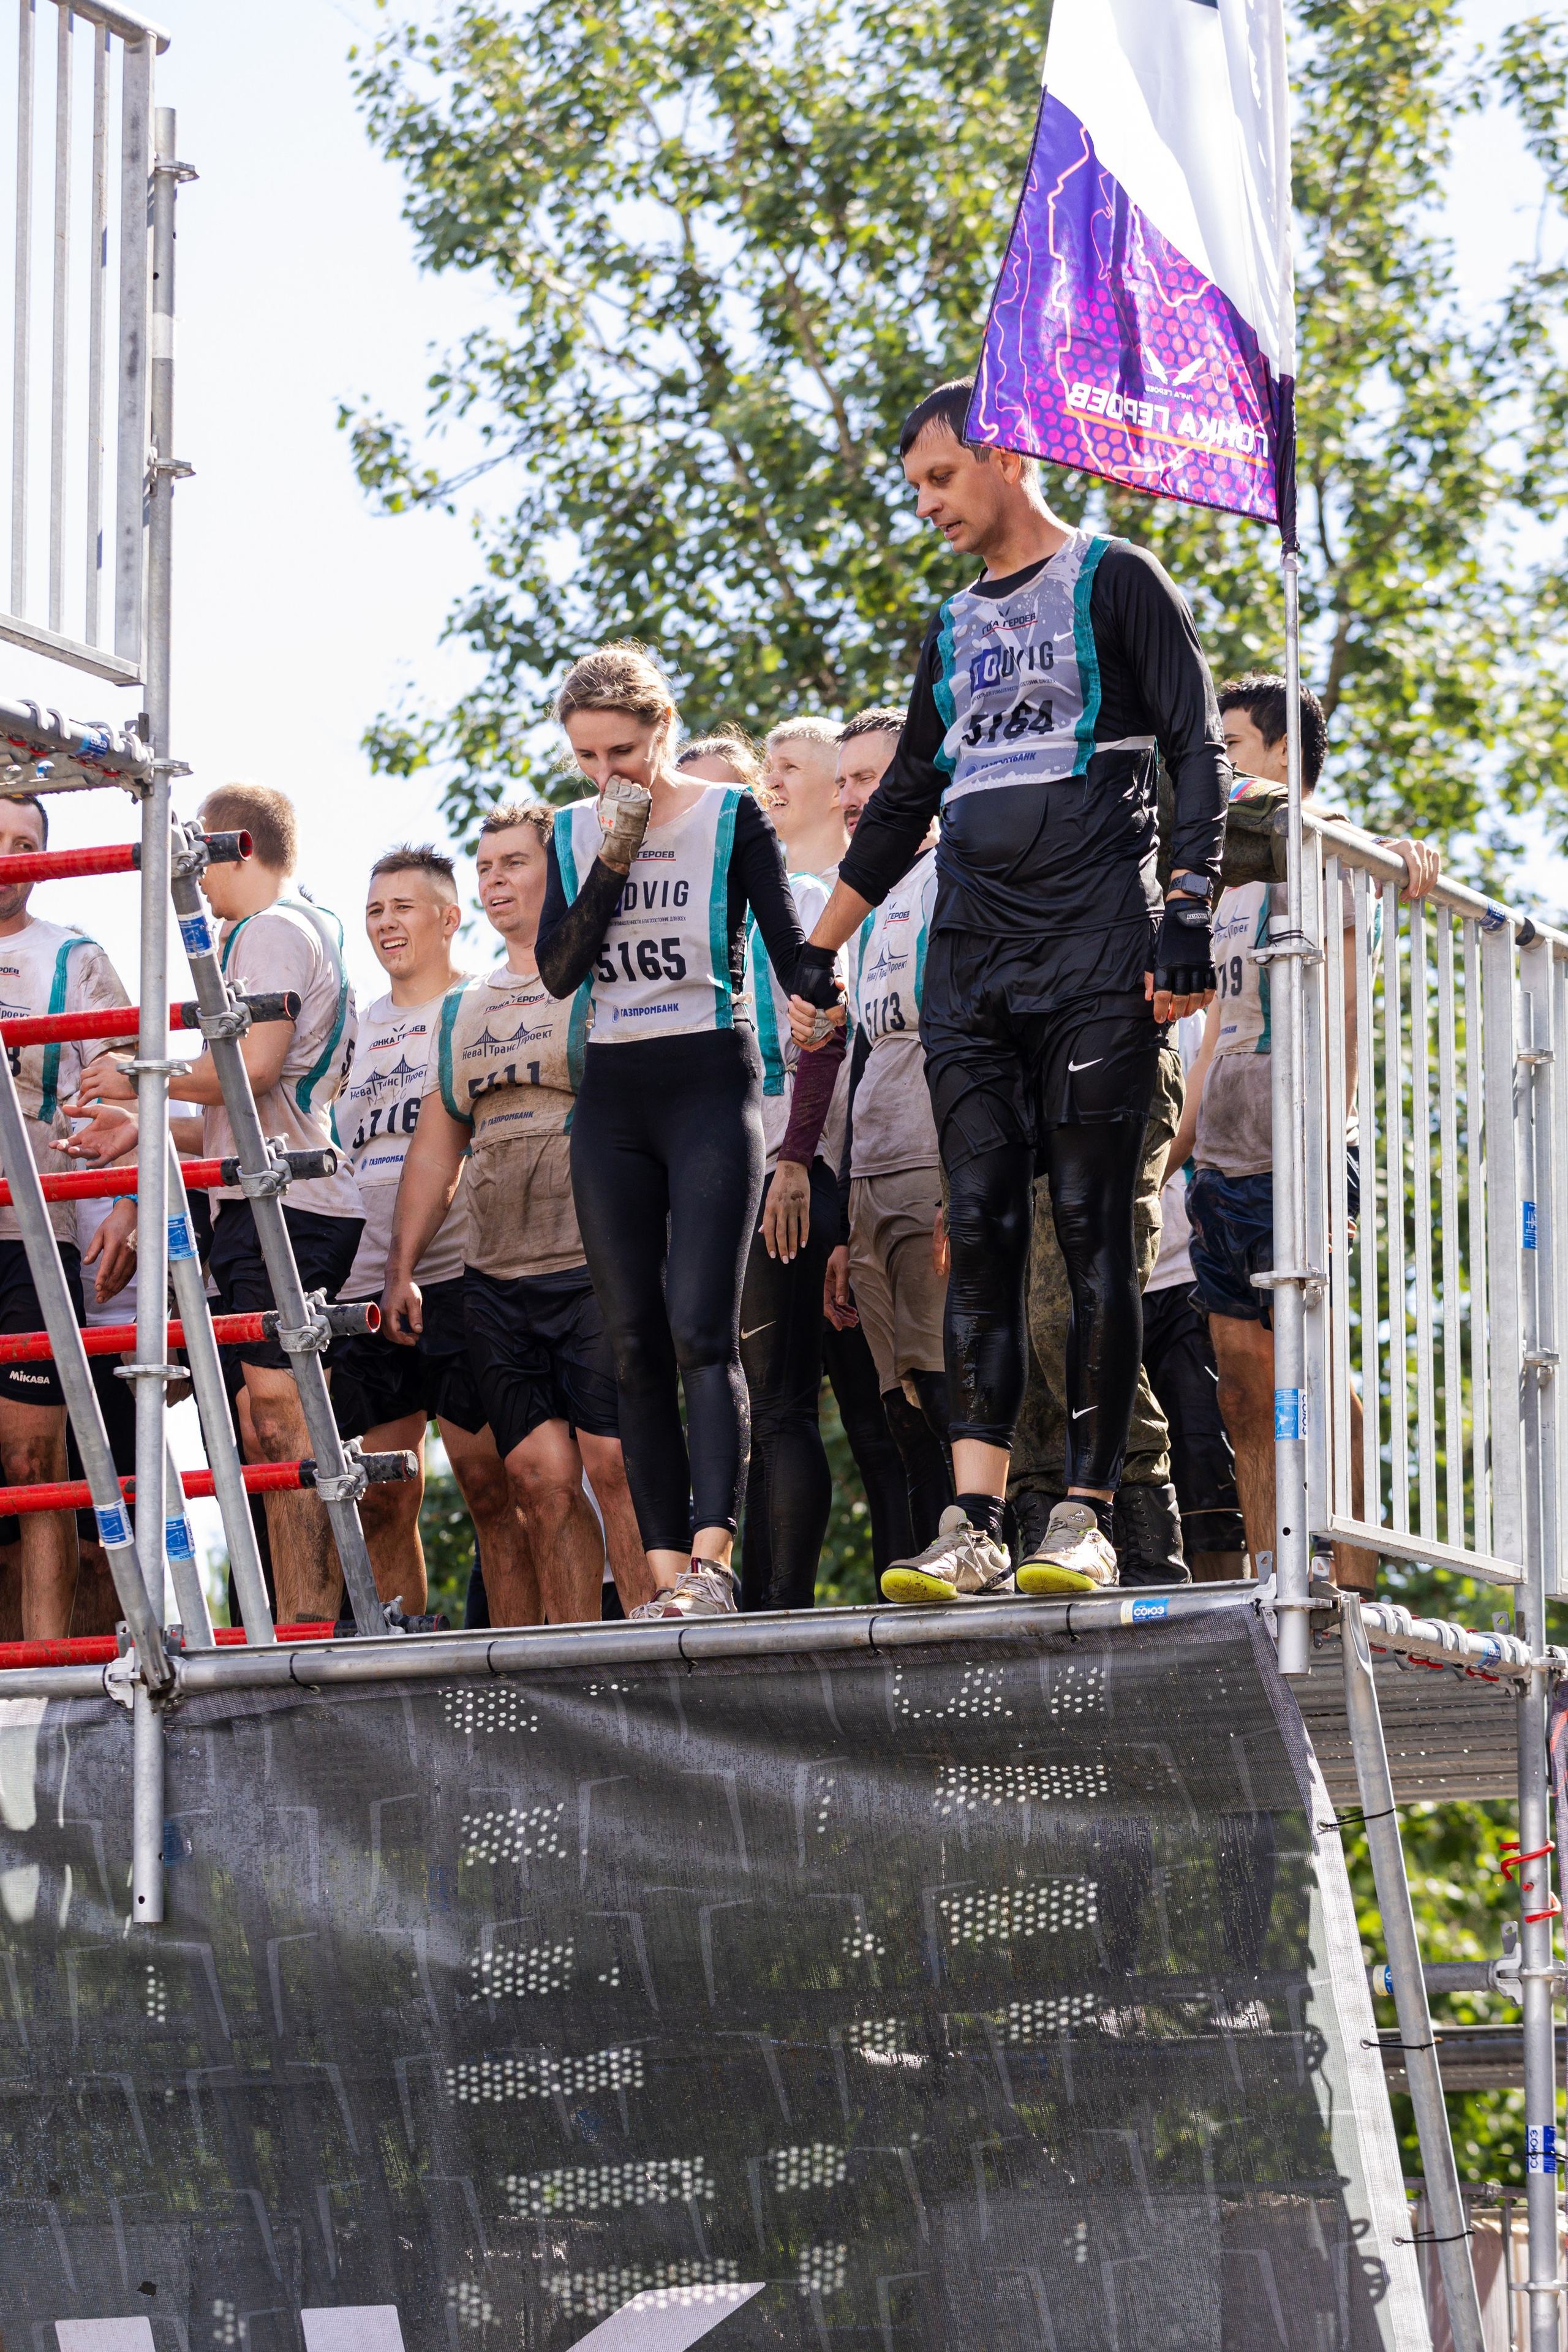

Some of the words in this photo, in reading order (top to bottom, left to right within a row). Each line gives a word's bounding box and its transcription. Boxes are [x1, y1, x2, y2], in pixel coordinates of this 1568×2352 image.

[1003, 612, 1036, 627] ГЕРОЕВ
[962, 700, 1054, 745] 5164
[596, 937, 687, 984] 5165
[620, 1002, 679, 1018] ГАЗПРОМБАНК
[462, 1047, 482, 1060] Нева
[489, 1042, 517, 1057] Транс
[350, 1087, 372, 1101] Нева
[488, 1110, 535, 1126] ГАЗПРОМБАНК
[369, 1155, 406, 1166] ГАЗПРОМБА
[1134, 1605, 1165, 1617] СОЮЗ
